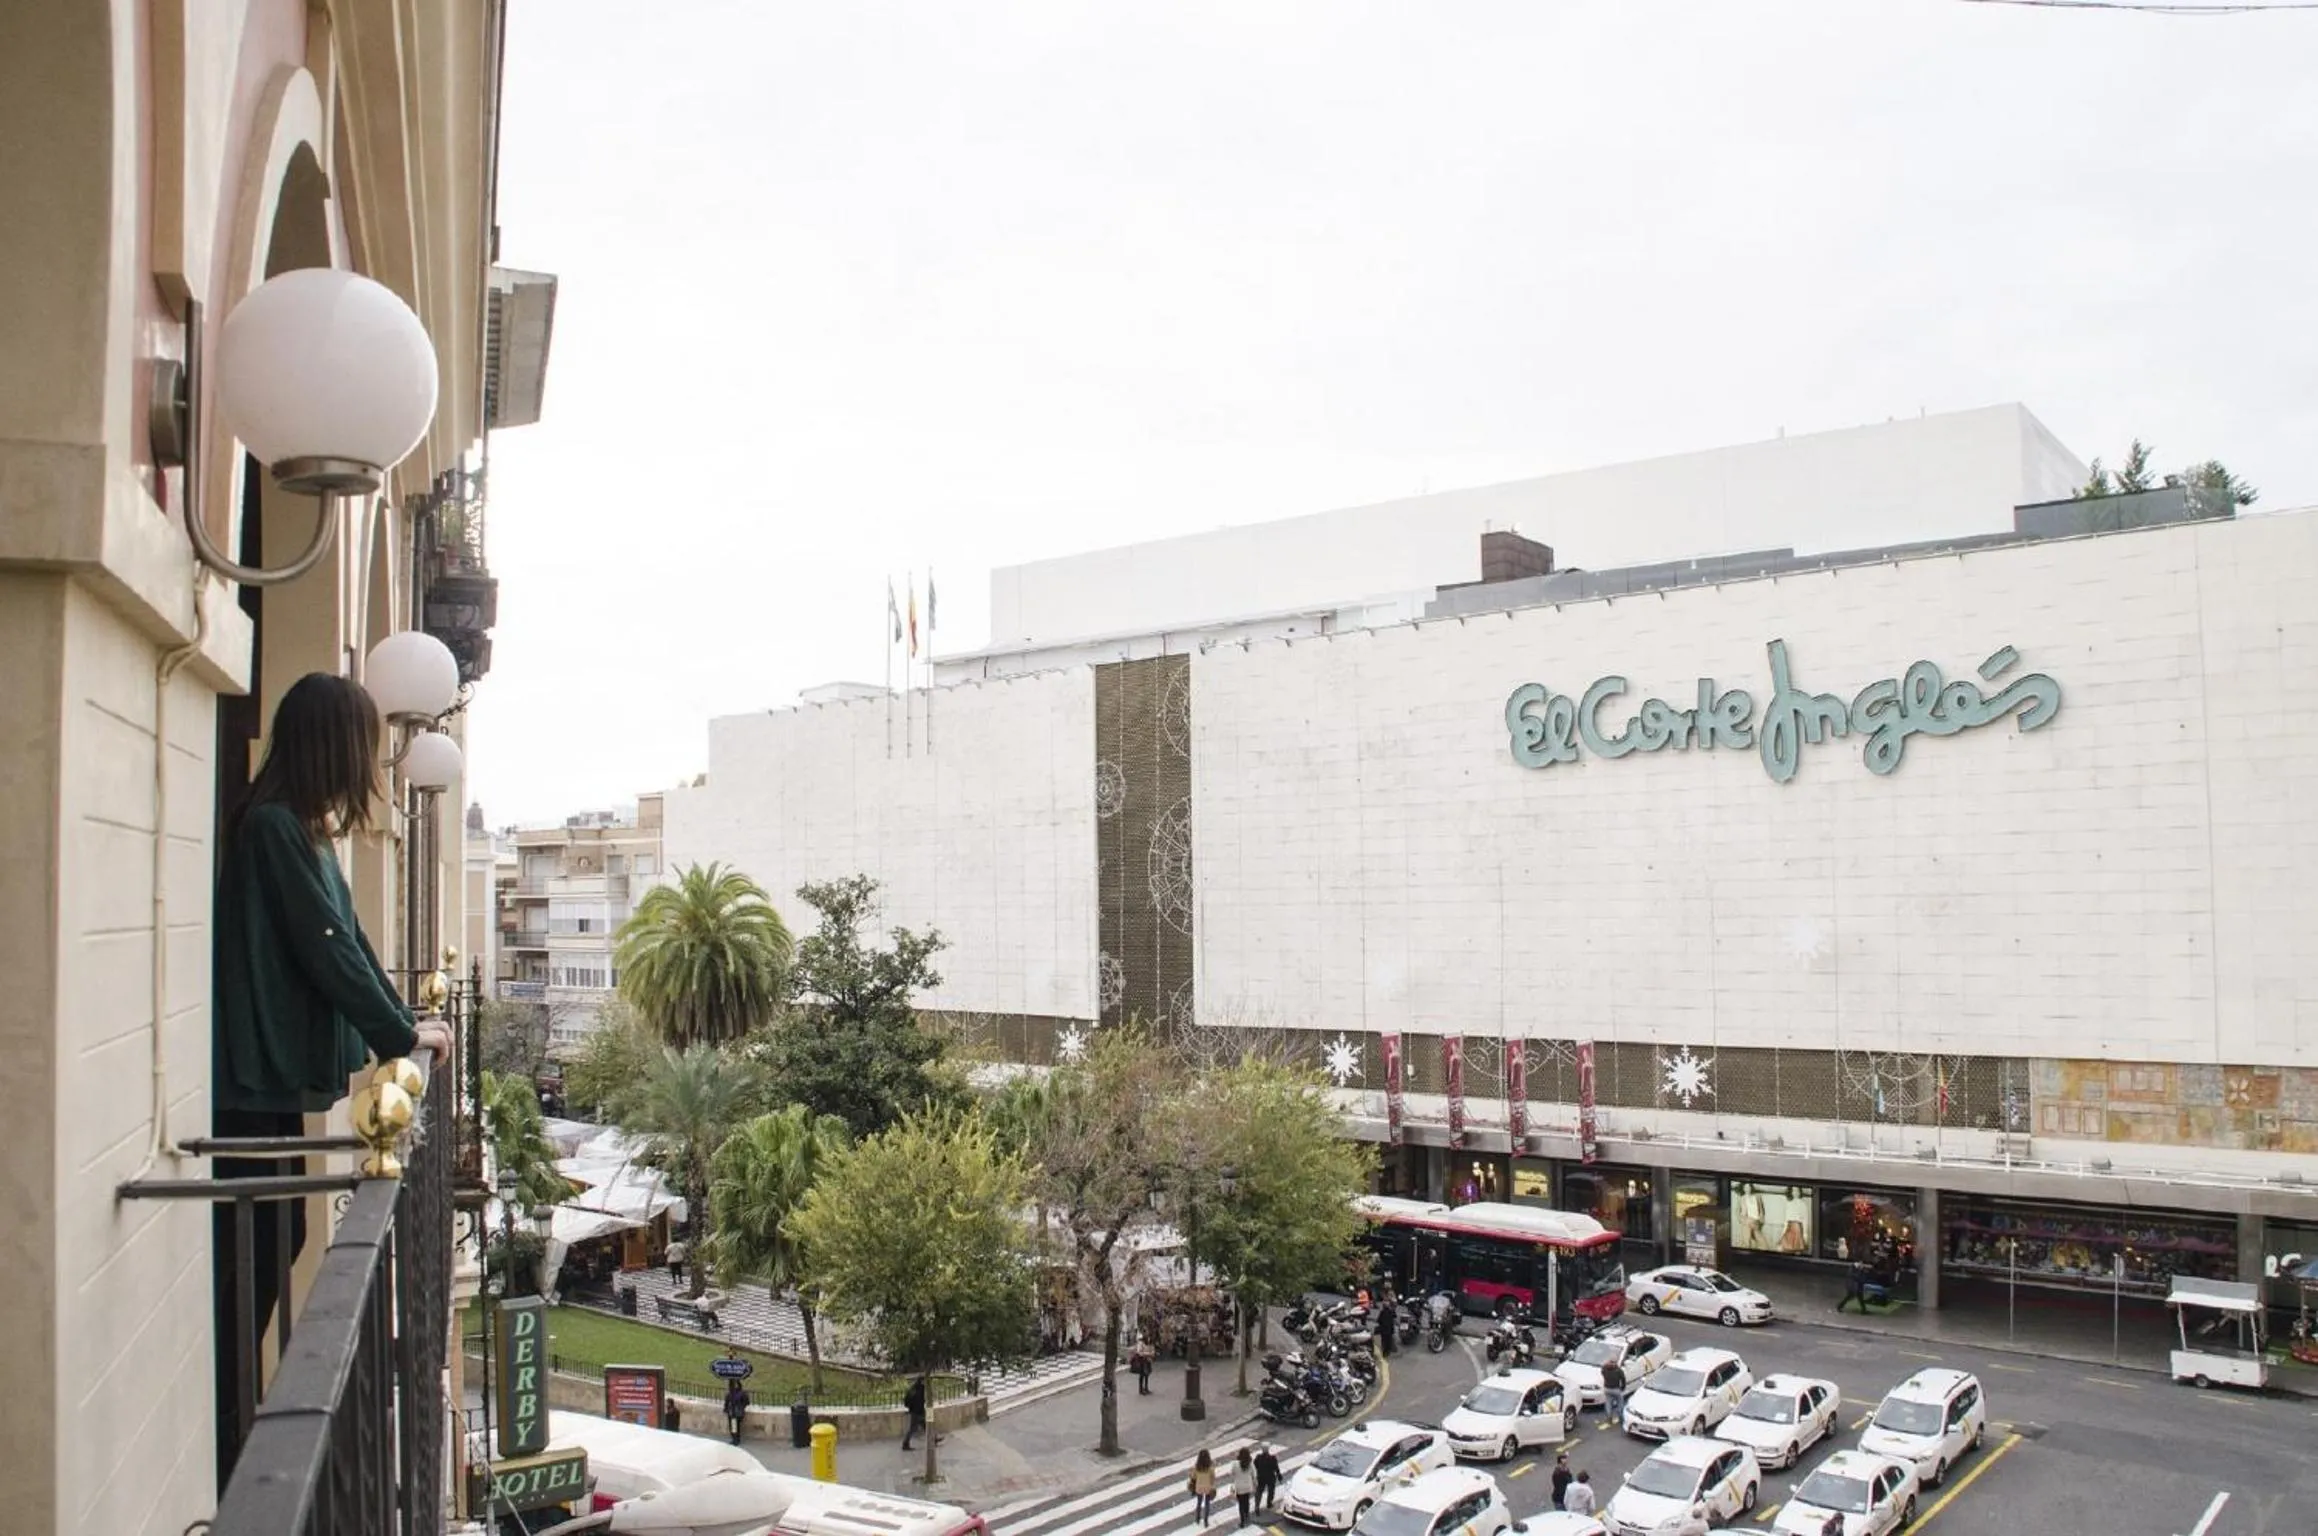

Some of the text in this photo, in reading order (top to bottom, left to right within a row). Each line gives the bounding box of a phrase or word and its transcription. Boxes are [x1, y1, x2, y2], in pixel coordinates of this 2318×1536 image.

[1505, 638, 2061, 783] El Corte Inglés
[514, 1311, 536, 1447] DERBY
